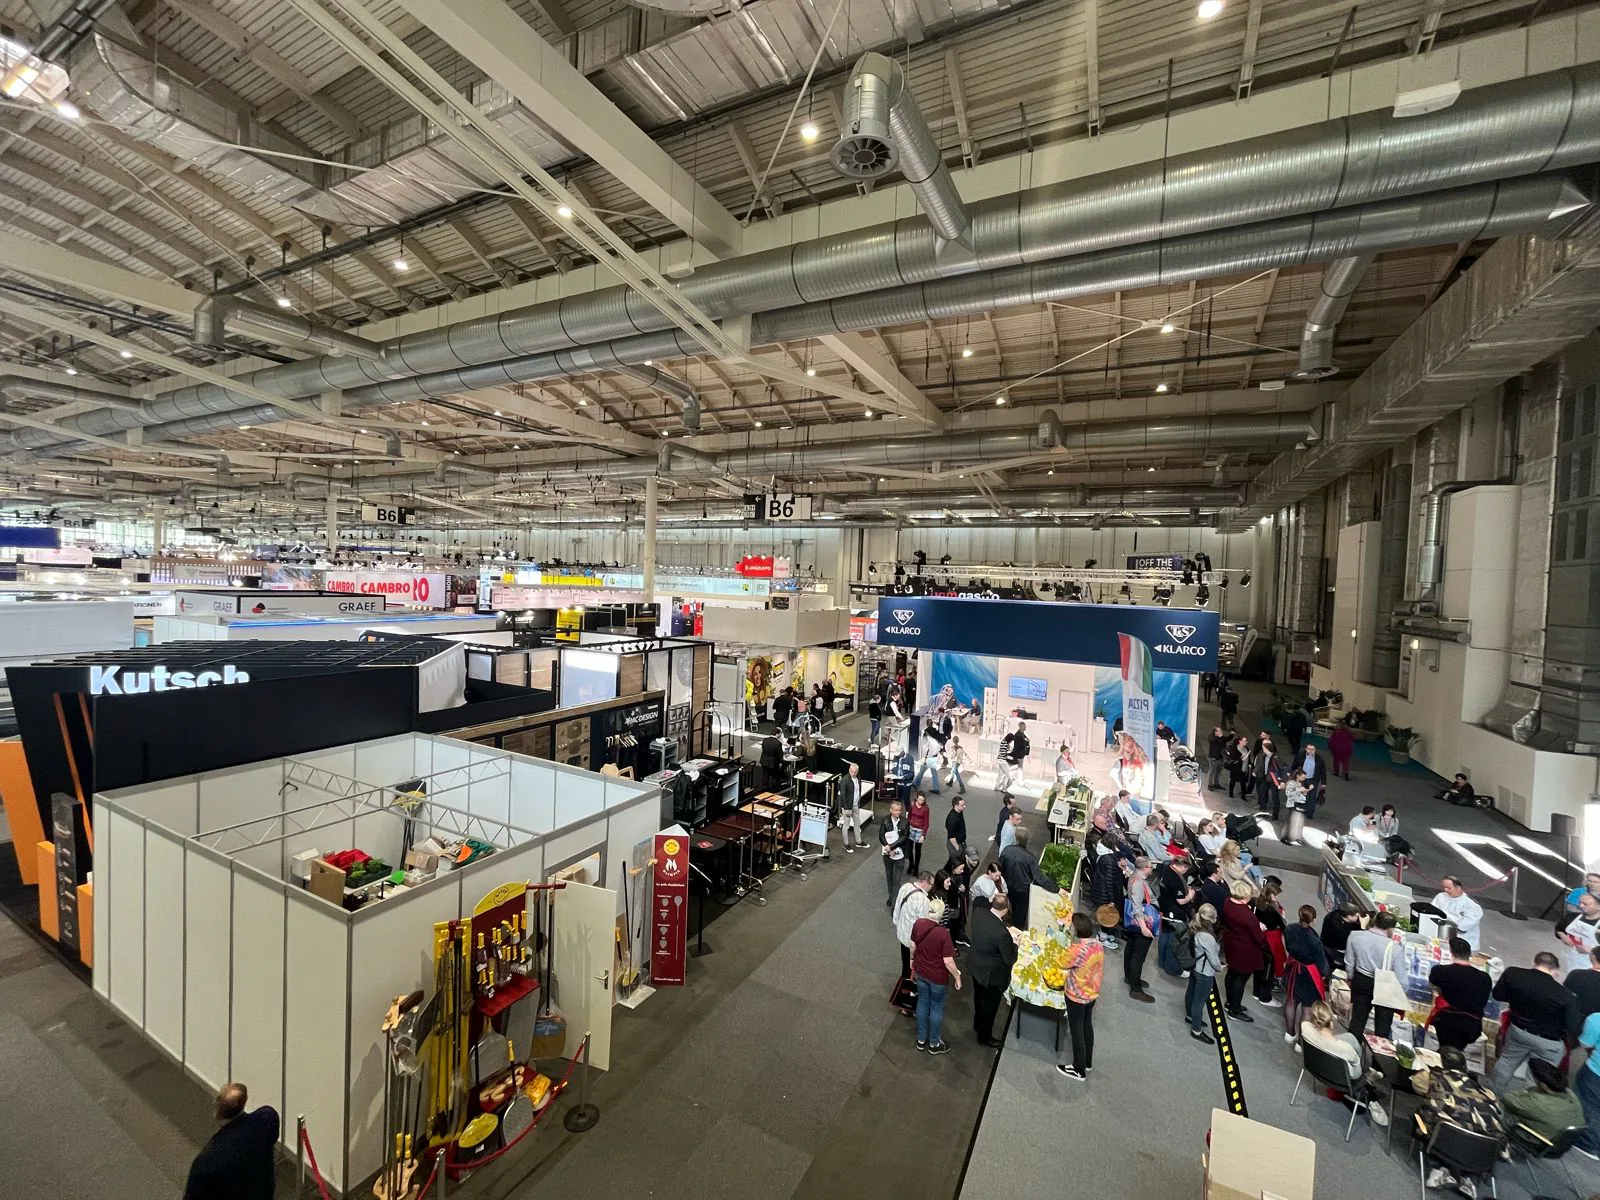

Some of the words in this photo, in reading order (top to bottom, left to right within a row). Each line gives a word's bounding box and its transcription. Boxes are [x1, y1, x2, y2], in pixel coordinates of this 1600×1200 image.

[377, 508, 397, 522] B6
[769, 500, 794, 518] B6
[1139, 558, 1154, 567] OFF
[1156, 558, 1173, 567] THE
[327, 580, 355, 593] CAMBRO
[360, 580, 411, 594] CAMBRO
[213, 601, 233, 613] GRAEF
[338, 602, 376, 612] GRAEF
[890, 626, 921, 636] KLARCO
[1170, 626, 1190, 638] T&S
[1162, 644, 1206, 656] KLARCO
[90, 664, 250, 695] Kutsch
